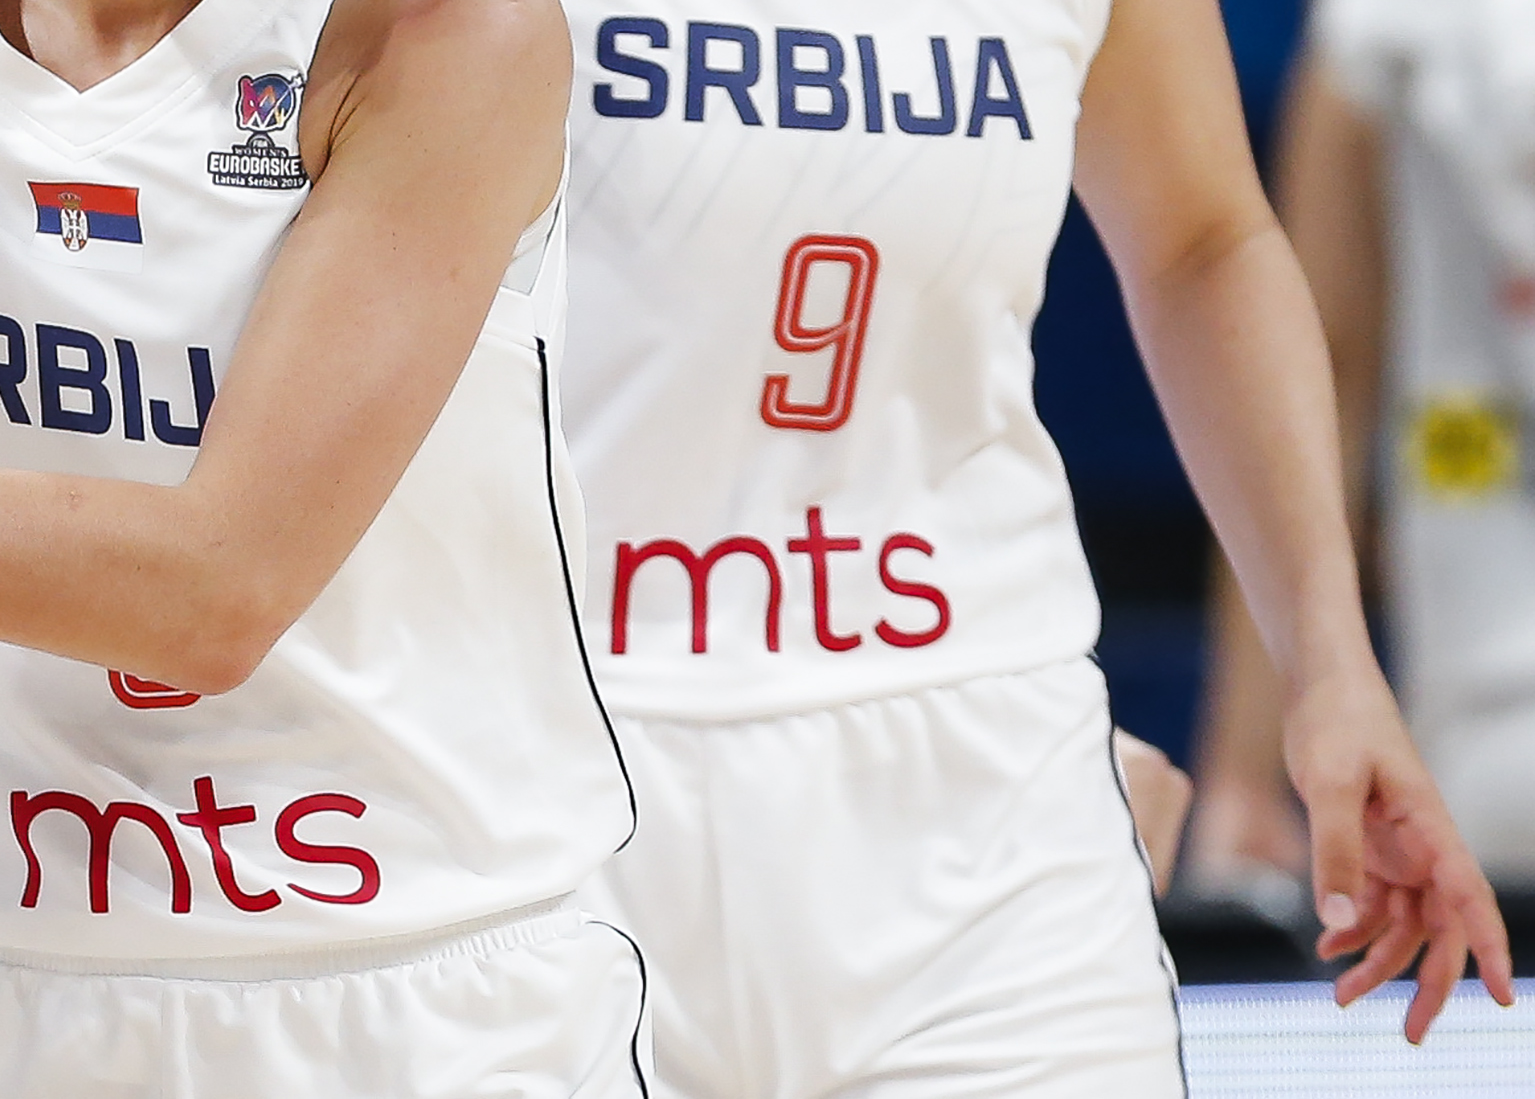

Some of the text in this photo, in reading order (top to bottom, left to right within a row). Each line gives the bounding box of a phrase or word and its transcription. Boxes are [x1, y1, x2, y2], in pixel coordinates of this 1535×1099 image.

[593, 16, 1033, 140] SRBIJA
[209, 153, 301, 177] EUROBASKE
[760, 233, 881, 432] 9
[610, 505, 952, 656] mts
[9, 775, 382, 915] mts
